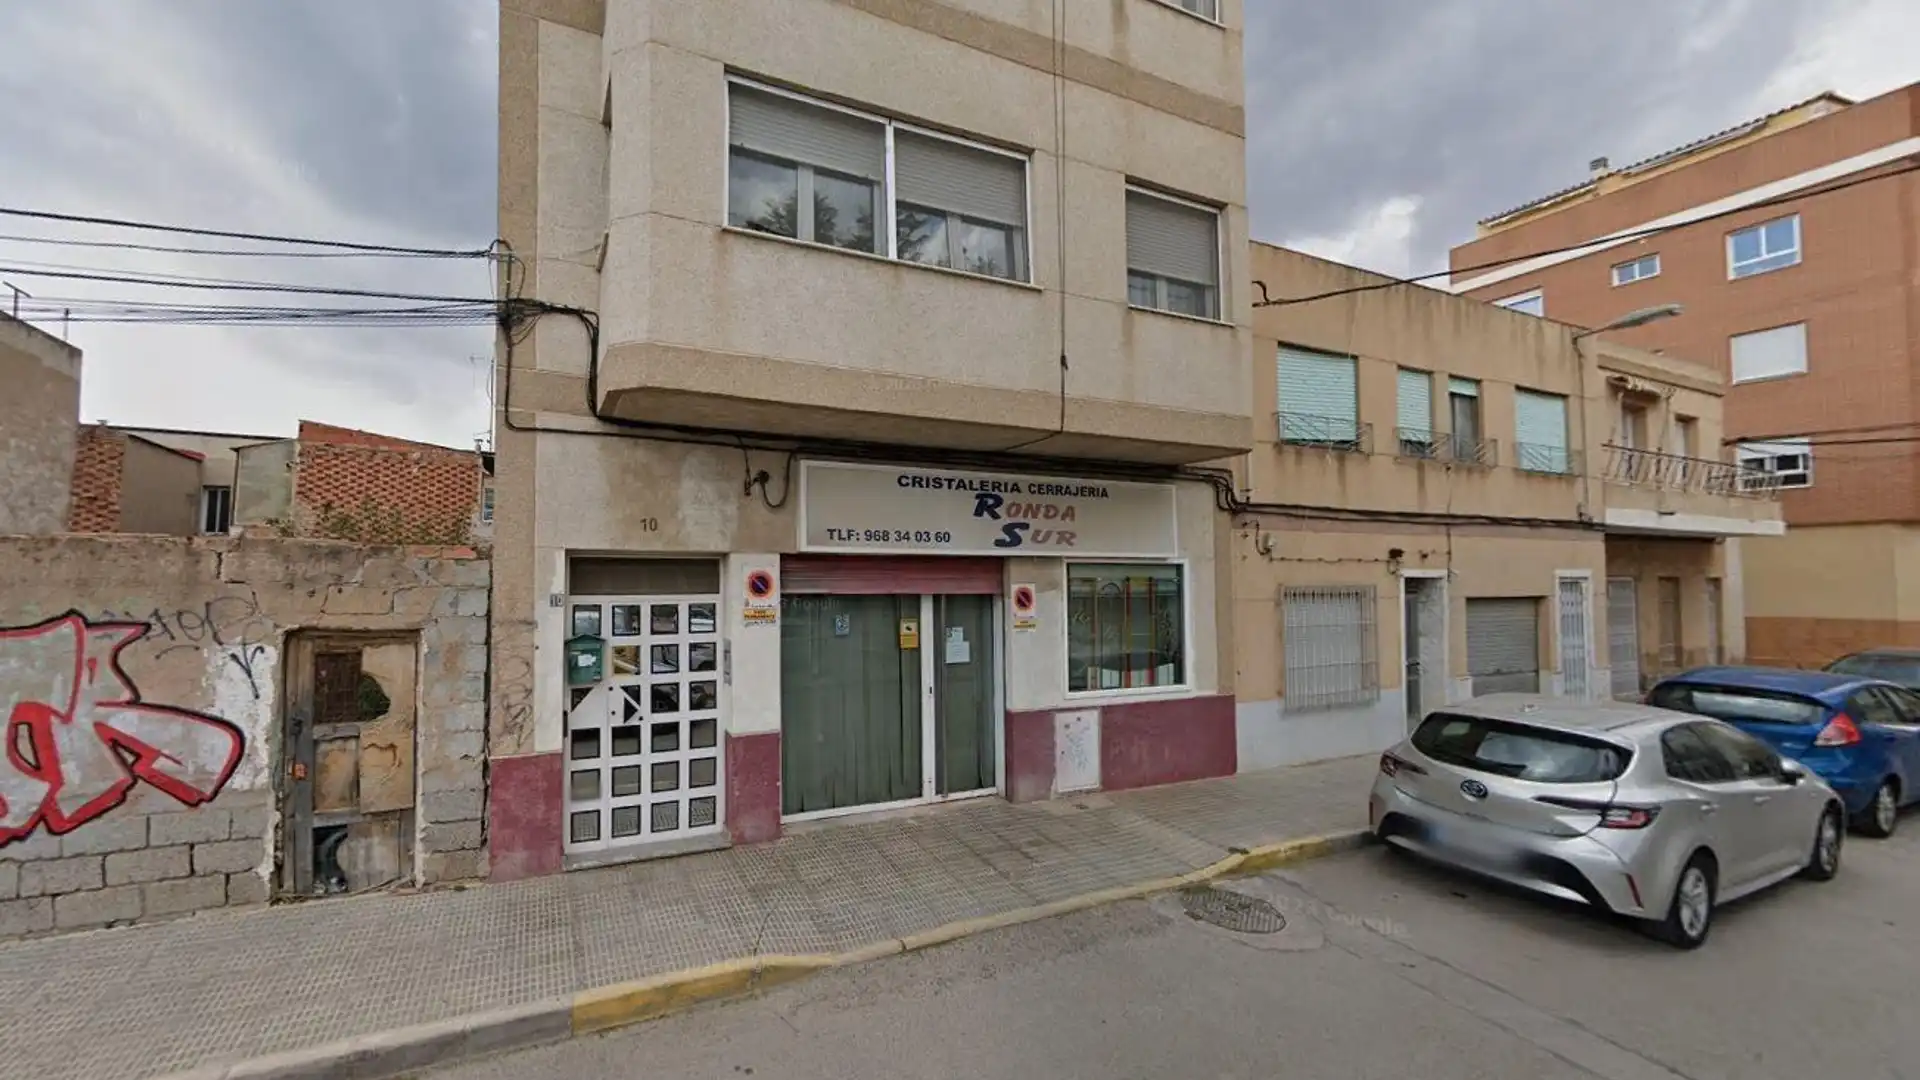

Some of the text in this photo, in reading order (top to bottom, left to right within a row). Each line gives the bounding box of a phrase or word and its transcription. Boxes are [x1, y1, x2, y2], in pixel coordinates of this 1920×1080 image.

[897, 475, 1109, 498] CRISTALERIA CERRAJERIA
[640, 517, 658, 532] 10
[827, 528, 950, 543] TLF: 968 34 03 60
